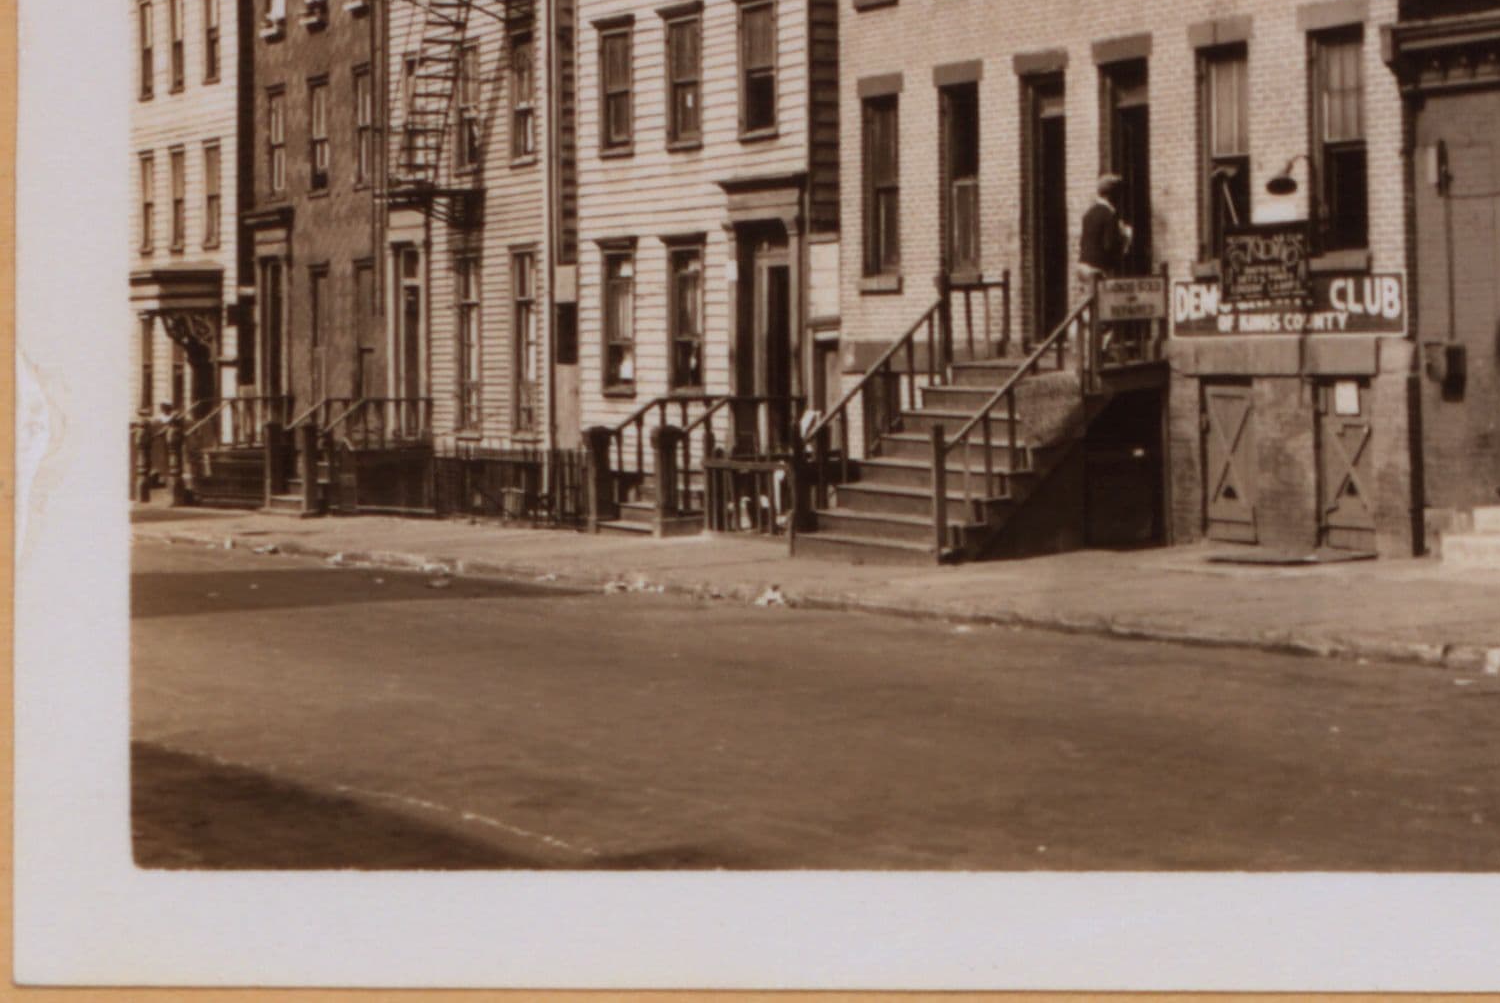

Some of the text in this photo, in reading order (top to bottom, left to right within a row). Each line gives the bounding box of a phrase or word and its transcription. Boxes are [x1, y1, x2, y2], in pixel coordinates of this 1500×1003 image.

[1329, 277, 1401, 319] CLUB
[1217, 314, 1234, 332] OF
[1284, 310, 1349, 331] CONTY
